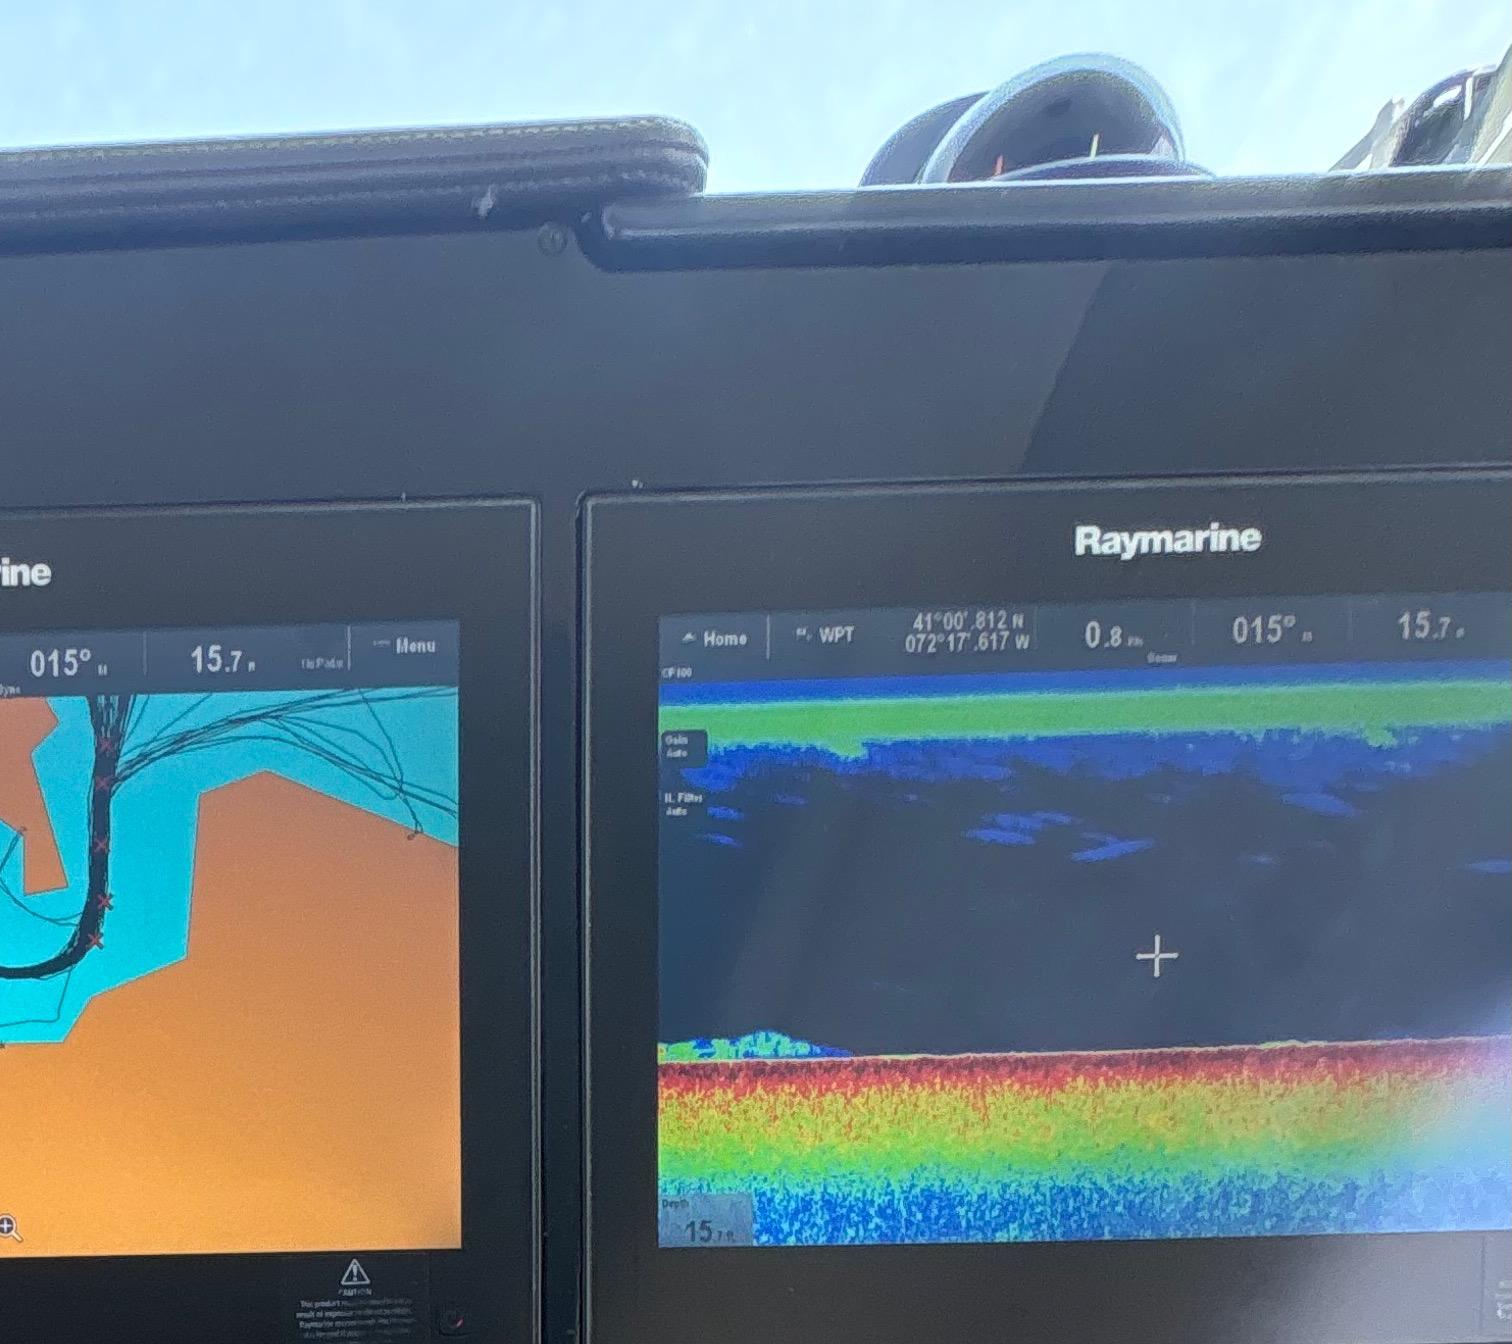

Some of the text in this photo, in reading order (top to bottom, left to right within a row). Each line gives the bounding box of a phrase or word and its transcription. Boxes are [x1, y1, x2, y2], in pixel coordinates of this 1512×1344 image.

[1074, 525, 1261, 560] Raymarine
[704, 630, 747, 647] Home
[819, 626, 855, 643] WPT
[396, 637, 435, 654] Menu
[190, 645, 242, 673] 15.7
